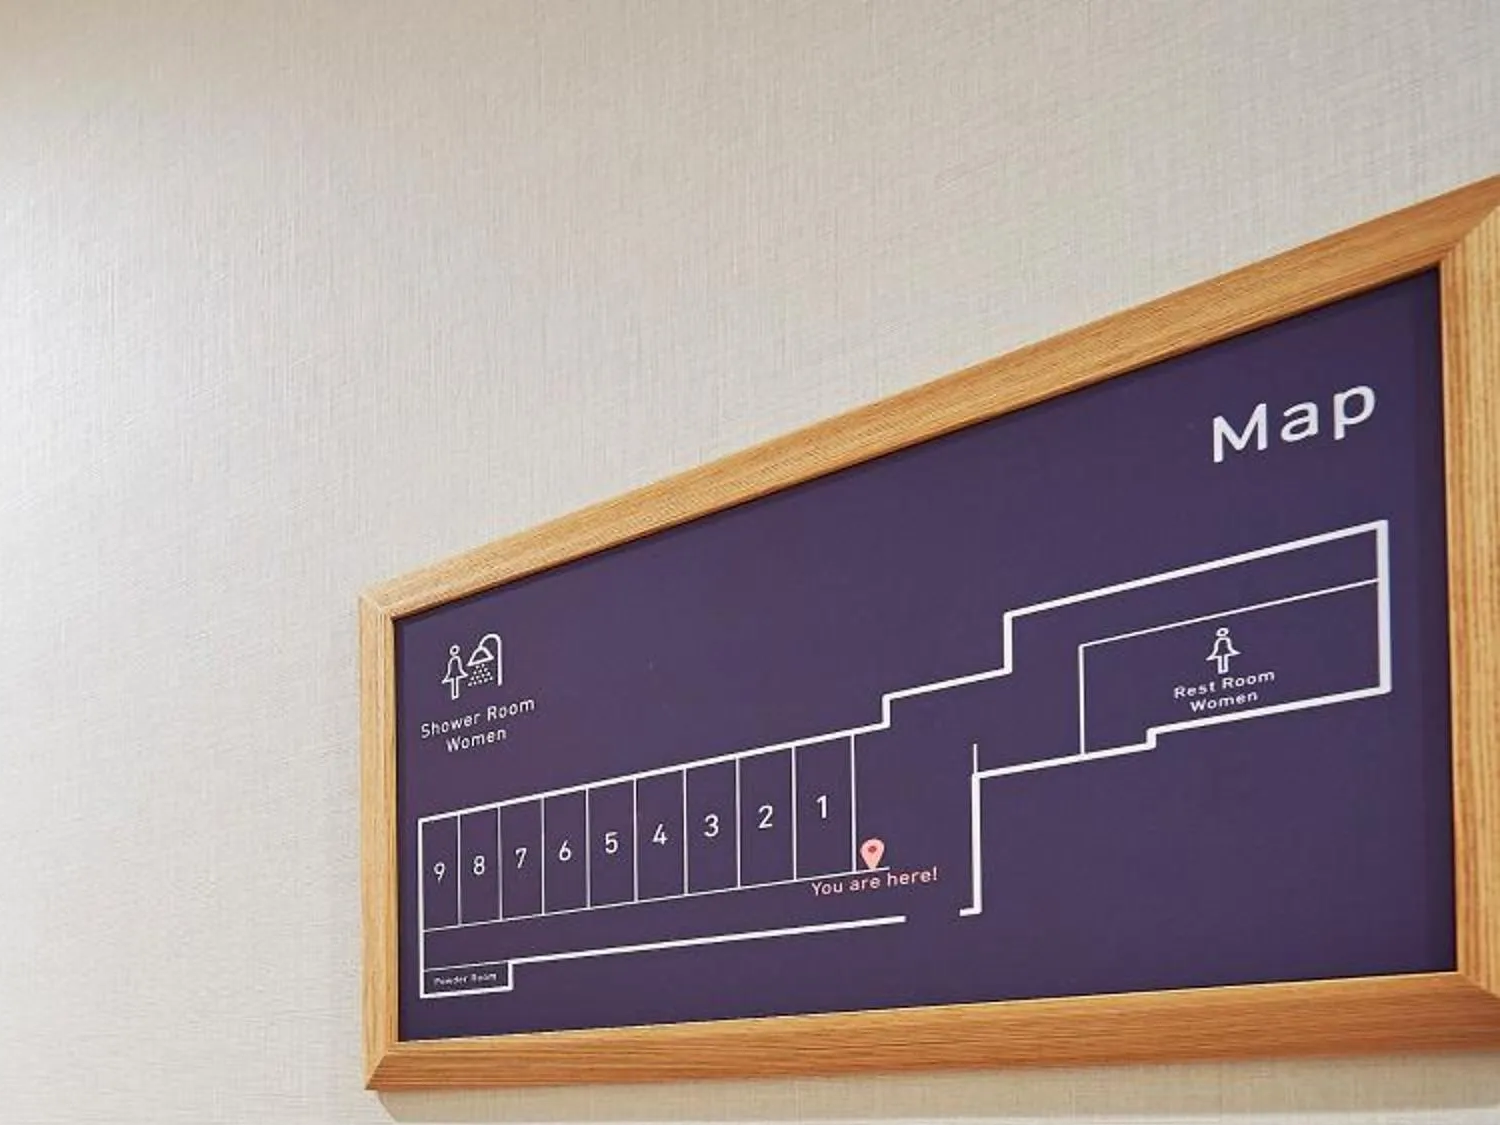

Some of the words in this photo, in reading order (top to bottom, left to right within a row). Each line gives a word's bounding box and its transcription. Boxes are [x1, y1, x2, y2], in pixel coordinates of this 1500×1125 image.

[1213, 385, 1376, 463] Map
[1174, 681, 1216, 700] Rest
[1221, 669, 1276, 689] Room
[1189, 691, 1258, 713] Women
[421, 713, 481, 739] Shower
[487, 699, 535, 721] Room
[445, 727, 507, 753] Women
[758, 804, 773, 829] 2
[816, 795, 828, 819] 1
[652, 823, 668, 845] 4
[704, 813, 719, 838] 3
[558, 840, 572, 861] 6
[605, 831, 619, 854] 5
[473, 855, 485, 876] 8
[515, 847, 528, 869] 7
[433, 862, 446, 882] 9
[811, 881, 843, 896] You
[849, 876, 881, 892] are
[886, 866, 938, 887] here!
